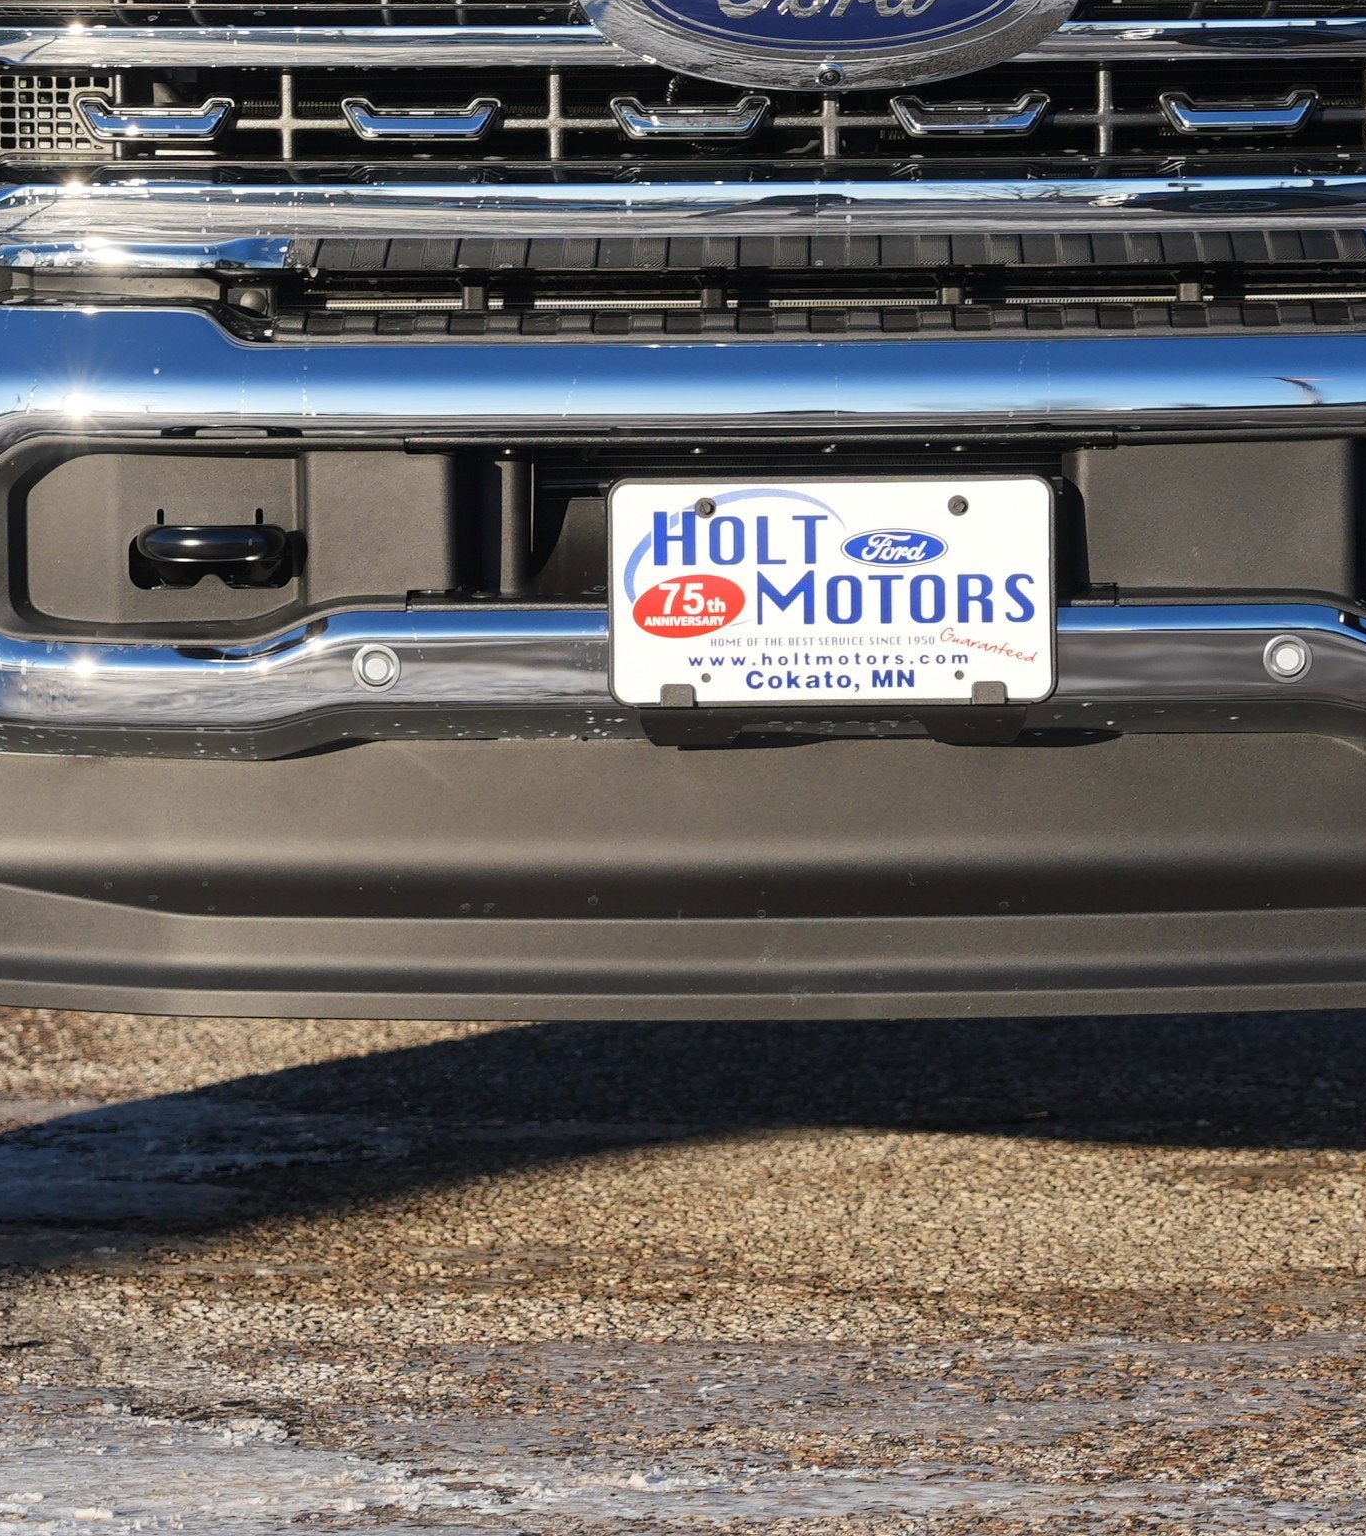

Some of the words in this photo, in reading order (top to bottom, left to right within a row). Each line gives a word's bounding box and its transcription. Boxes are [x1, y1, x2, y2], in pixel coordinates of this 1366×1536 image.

[653, 511, 828, 566] HOLT
[861, 533, 928, 561] Ford
[658, 582, 726, 615] 75th
[757, 570, 1035, 625] MOTORS
[644, 615, 726, 627] ANNIVERSARY
[710, 638, 742, 647] HOME
[747, 638, 760, 647] OF
[765, 637, 783, 646] THE
[788, 637, 814, 646] BEST
[818, 637, 866, 646] SERVICE
[870, 636, 902, 646] SINCE
[908, 636, 935, 645] 1950
[940, 627, 1038, 663] Guaranteed
[688, 653, 969, 667] www.holtmotors.com
[746, 669, 860, 692] Cokato,
[872, 669, 915, 688] MN
